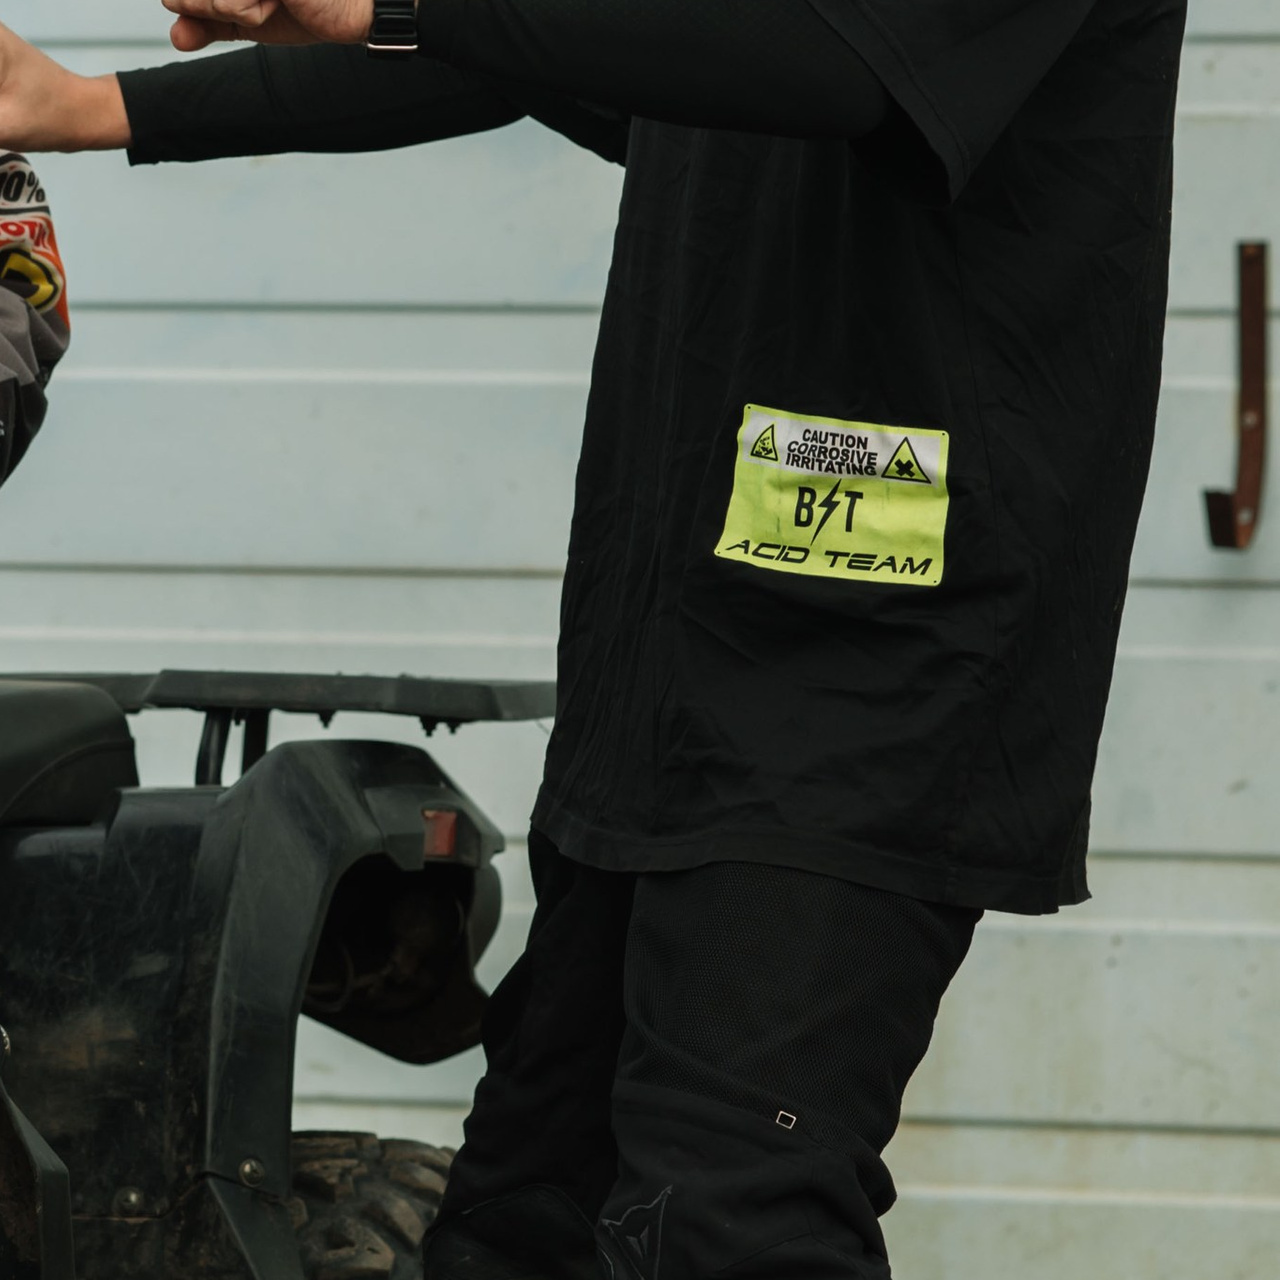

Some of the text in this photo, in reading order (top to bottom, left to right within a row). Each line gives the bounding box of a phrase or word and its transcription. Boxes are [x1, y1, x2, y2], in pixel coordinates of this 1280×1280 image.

[802, 428, 868, 450] CAUTION
[785, 452, 877, 476] IRRITATING
[787, 440, 878, 466] CORROSIVE
[725, 539, 933, 576] ACID TEAM
